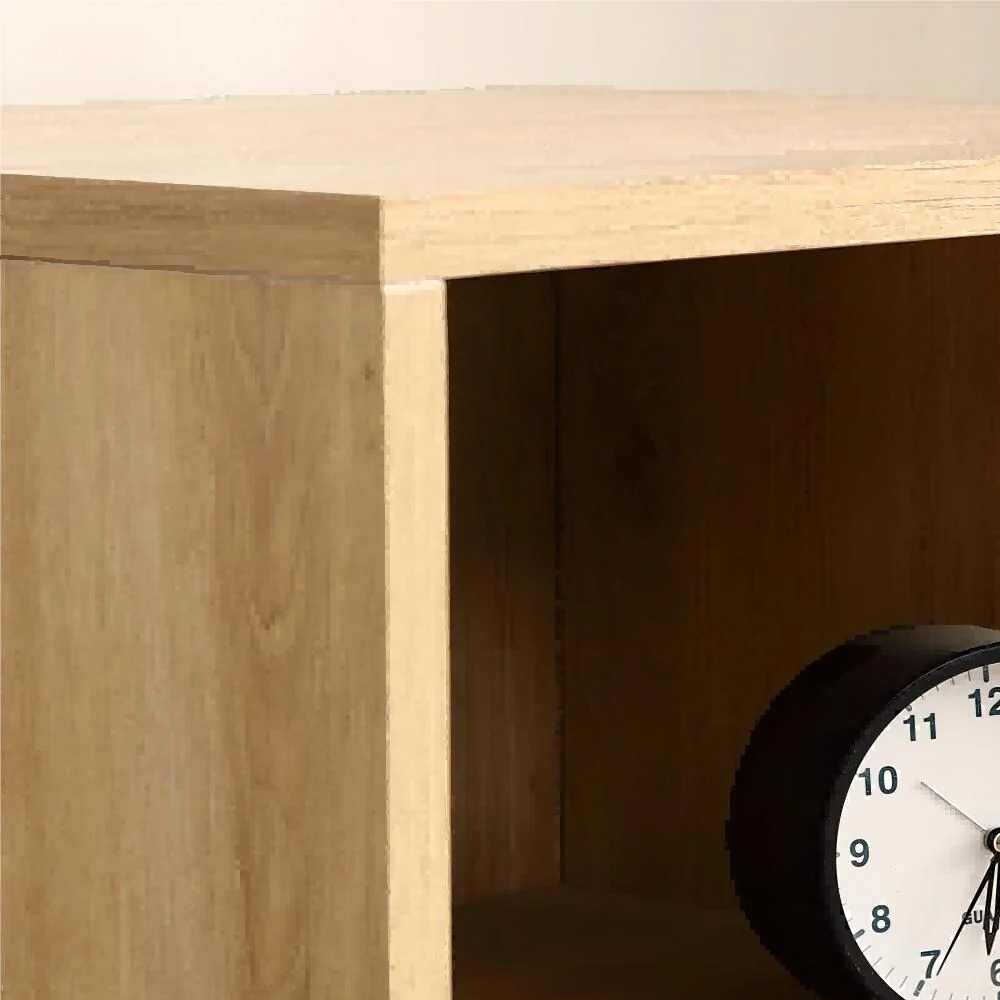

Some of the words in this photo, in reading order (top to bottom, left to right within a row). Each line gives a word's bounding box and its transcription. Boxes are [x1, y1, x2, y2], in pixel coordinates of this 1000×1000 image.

[903, 713, 938, 742] 11
[858, 765, 899, 796] 10
[849, 838, 871, 868] 9
[870, 904, 892, 934] 8
[919, 949, 942, 979] 7
